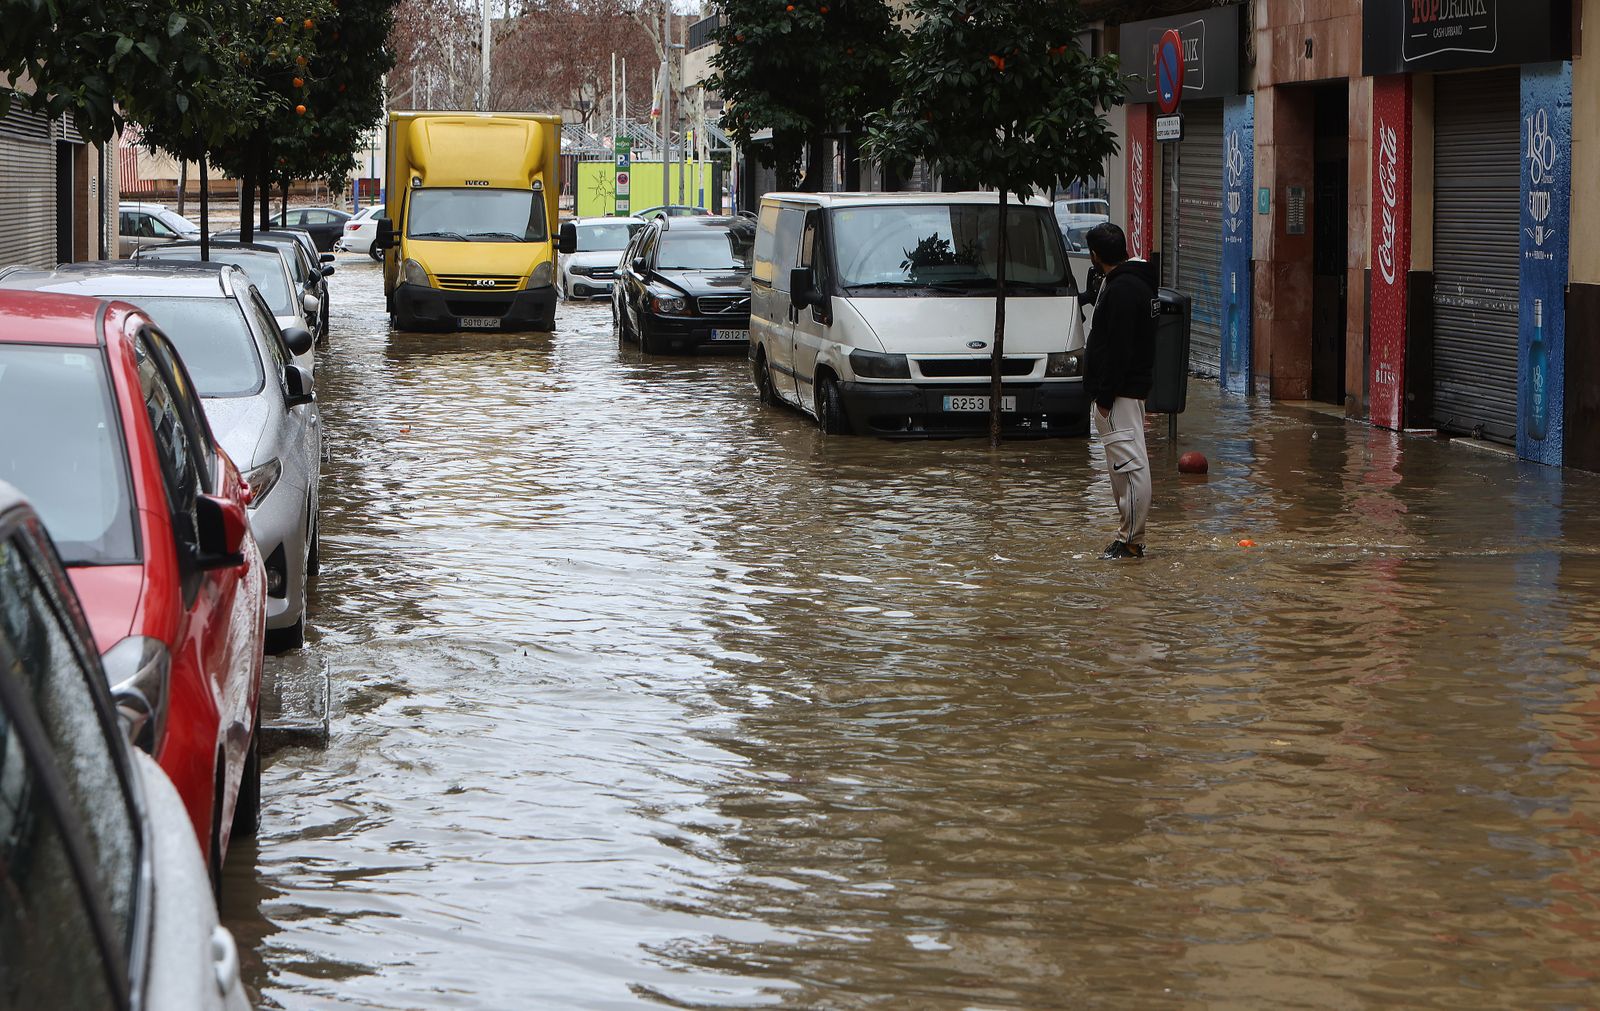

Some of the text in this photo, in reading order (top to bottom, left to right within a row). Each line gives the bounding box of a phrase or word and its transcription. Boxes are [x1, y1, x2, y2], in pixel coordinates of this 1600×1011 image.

[720, 330, 740, 339] 7812
[1375, 369, 1396, 385] BLISS
[952, 398, 984, 410] 6253
